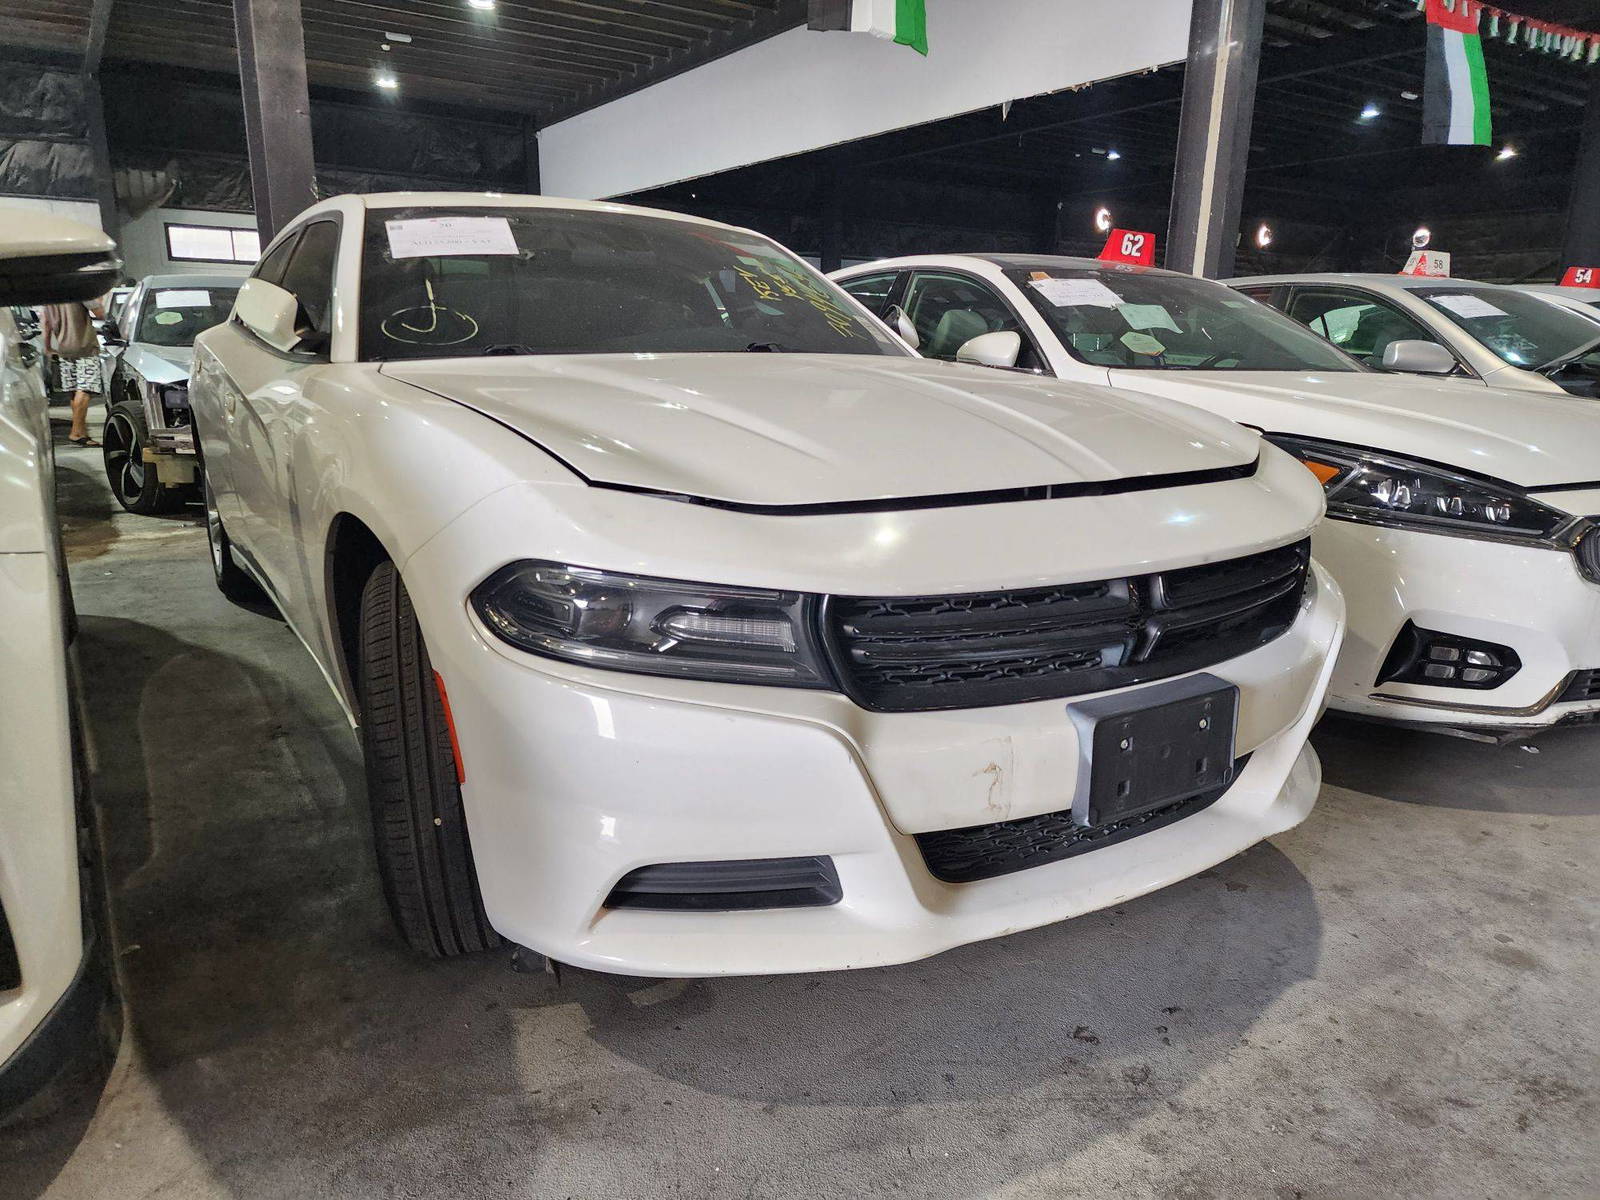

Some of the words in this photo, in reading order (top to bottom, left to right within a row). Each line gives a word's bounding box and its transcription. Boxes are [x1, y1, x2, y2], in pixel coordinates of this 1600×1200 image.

[1121, 233, 1144, 257] 62
[1433, 259, 1444, 270] 58
[1575, 269, 1593, 284] 54
